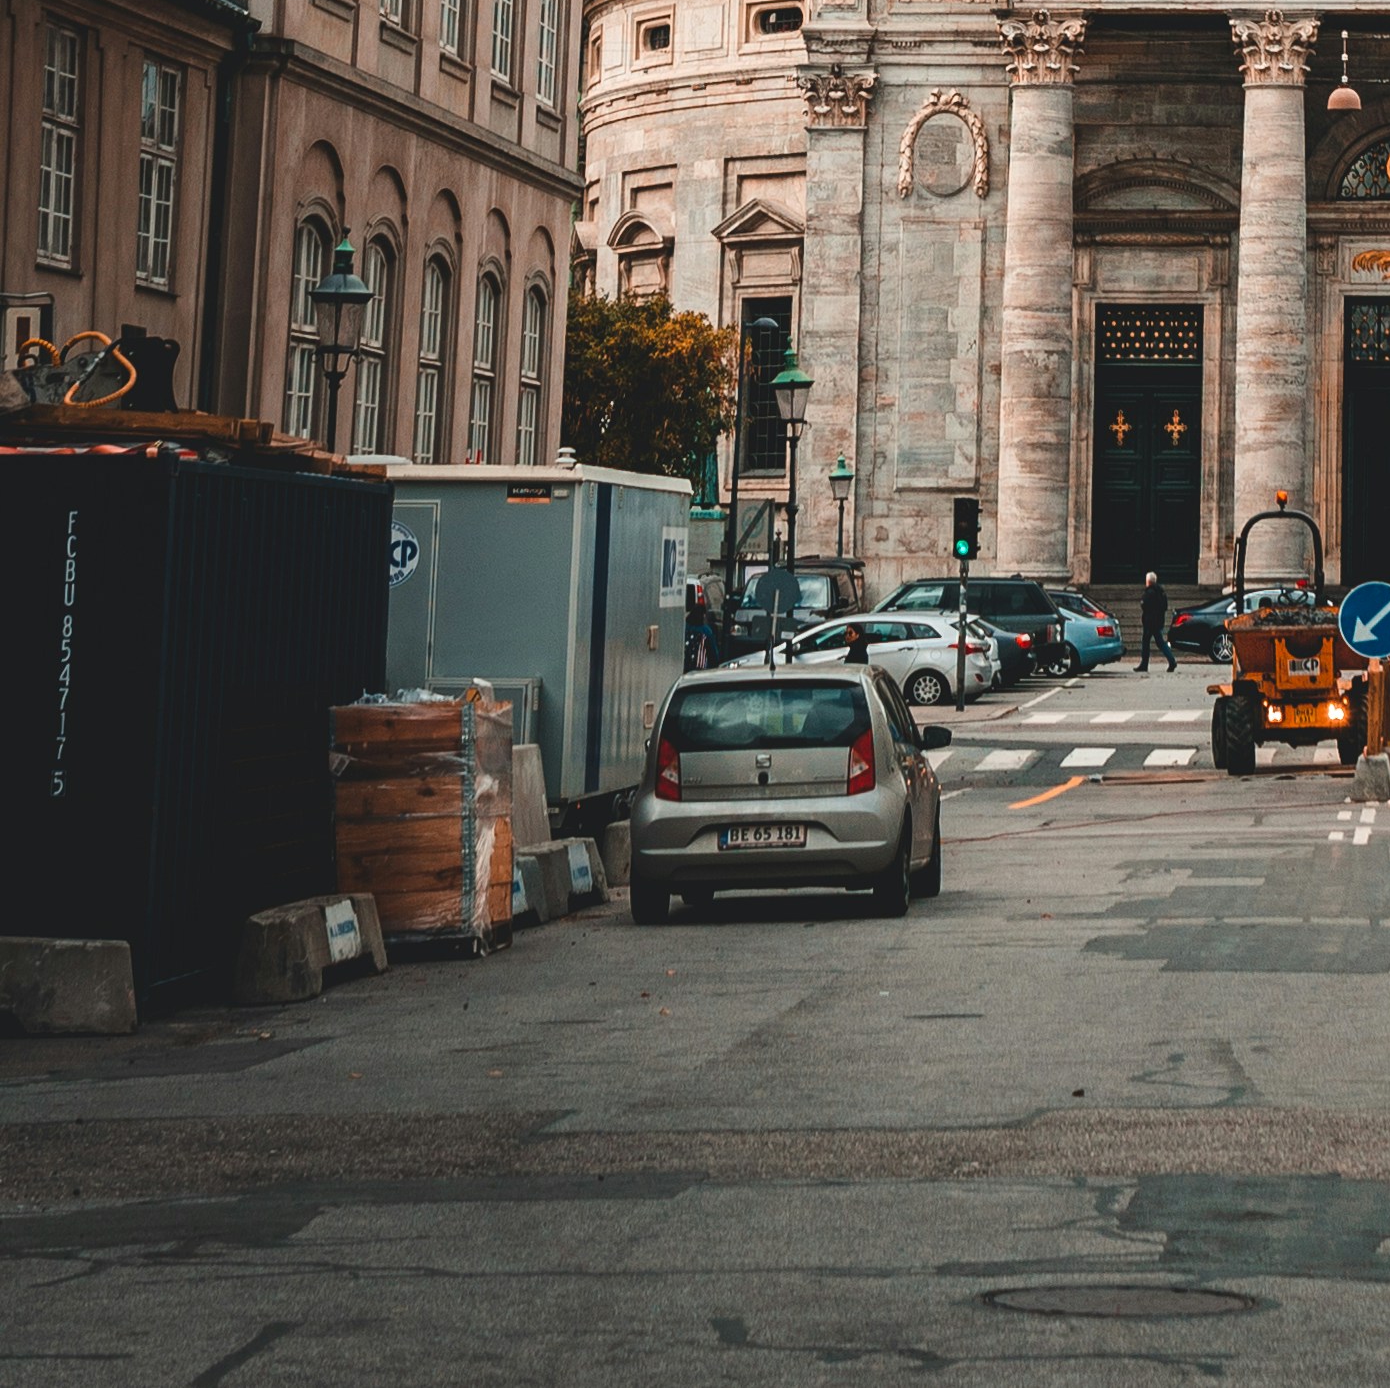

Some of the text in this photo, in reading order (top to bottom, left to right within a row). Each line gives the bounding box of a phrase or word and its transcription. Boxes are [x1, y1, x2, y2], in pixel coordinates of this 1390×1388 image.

[64, 510, 78, 606] FCBU
[56, 615, 73, 760] 854717
[729, 825, 801, 842] BE 65 181
